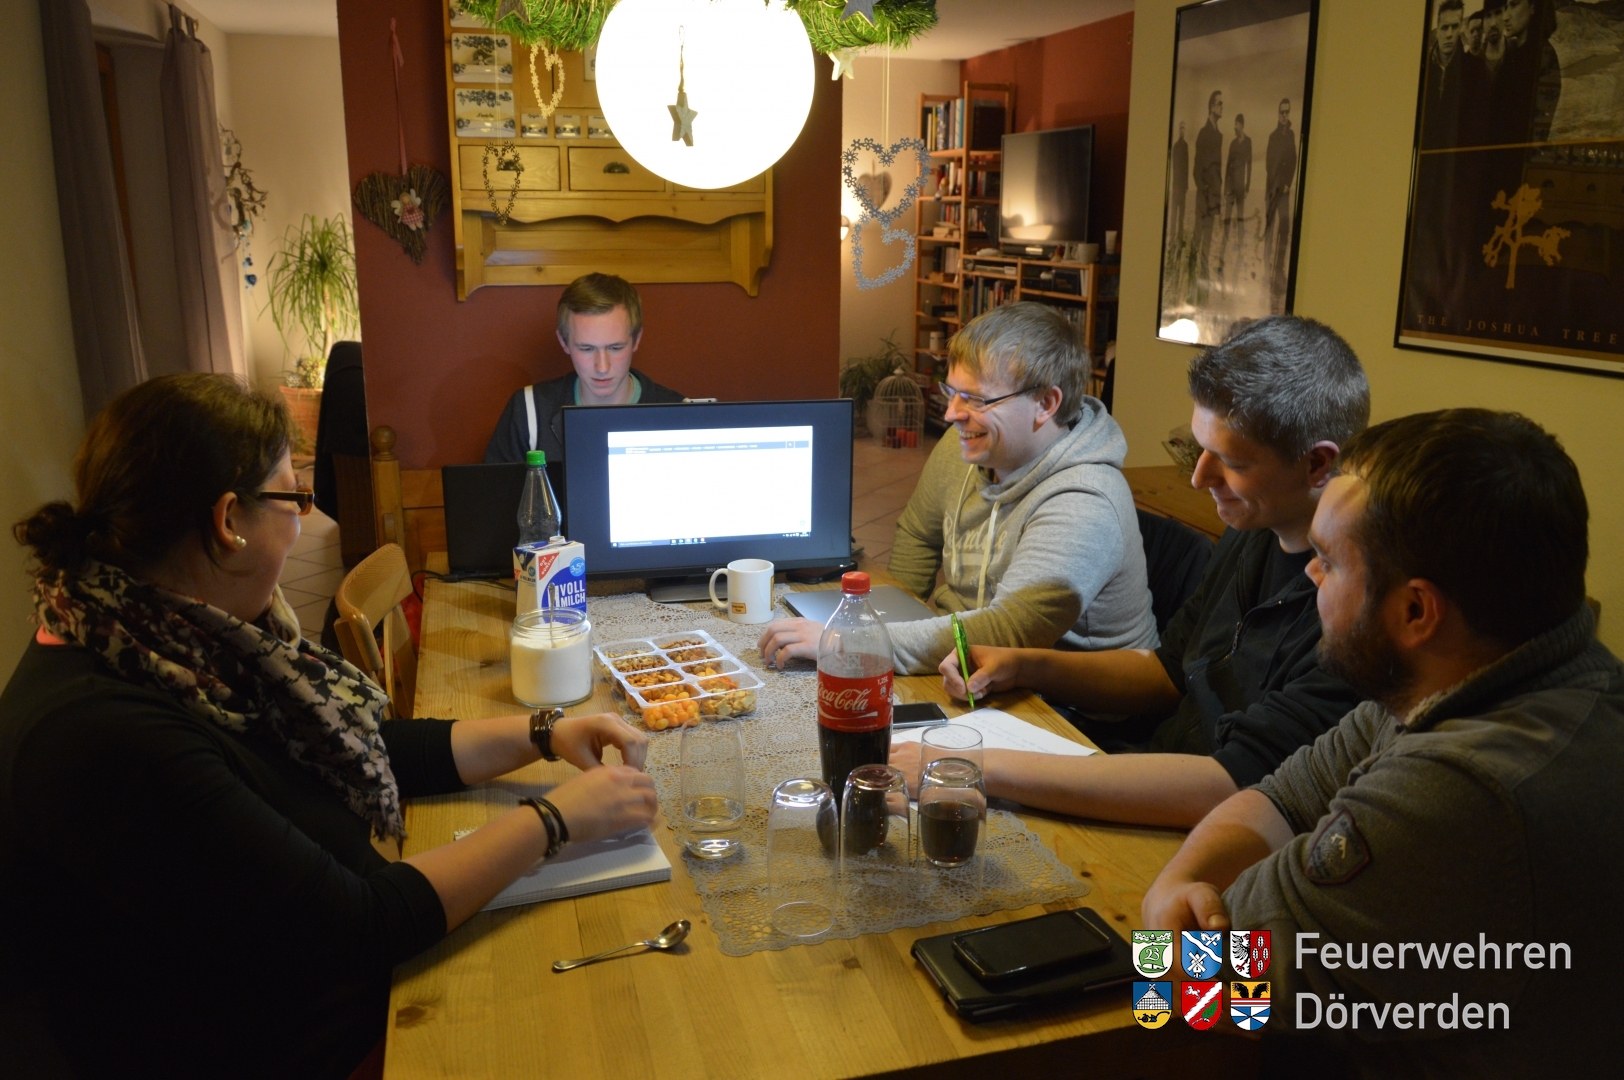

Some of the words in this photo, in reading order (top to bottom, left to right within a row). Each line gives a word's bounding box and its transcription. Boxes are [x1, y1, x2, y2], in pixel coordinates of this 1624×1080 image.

[1416, 314, 1448, 326] THE
[1466, 319, 1540, 337] JOSHUA
[1562, 328, 1618, 345] TREE
[560, 579, 586, 597] VOLL
[560, 592, 586, 608] MILCH
